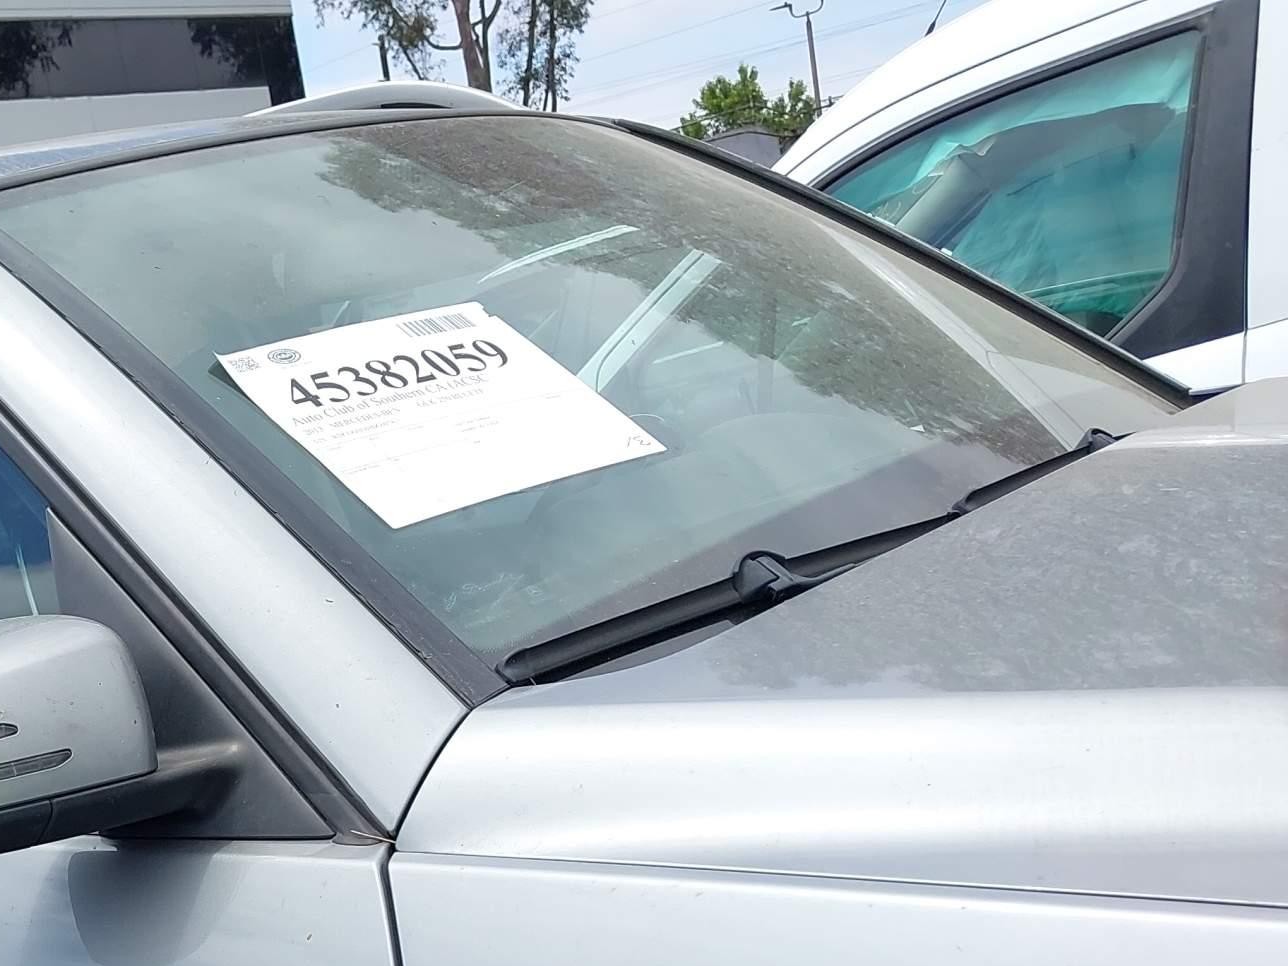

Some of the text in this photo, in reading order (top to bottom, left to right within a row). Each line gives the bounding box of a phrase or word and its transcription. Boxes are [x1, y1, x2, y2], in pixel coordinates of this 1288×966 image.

[290, 339, 508, 407] 45382059
[292, 413, 324, 427] Auto
[323, 404, 356, 418] Club
[356, 398, 372, 409] of
[370, 387, 426, 406] Southern
[424, 381, 448, 394] CA
